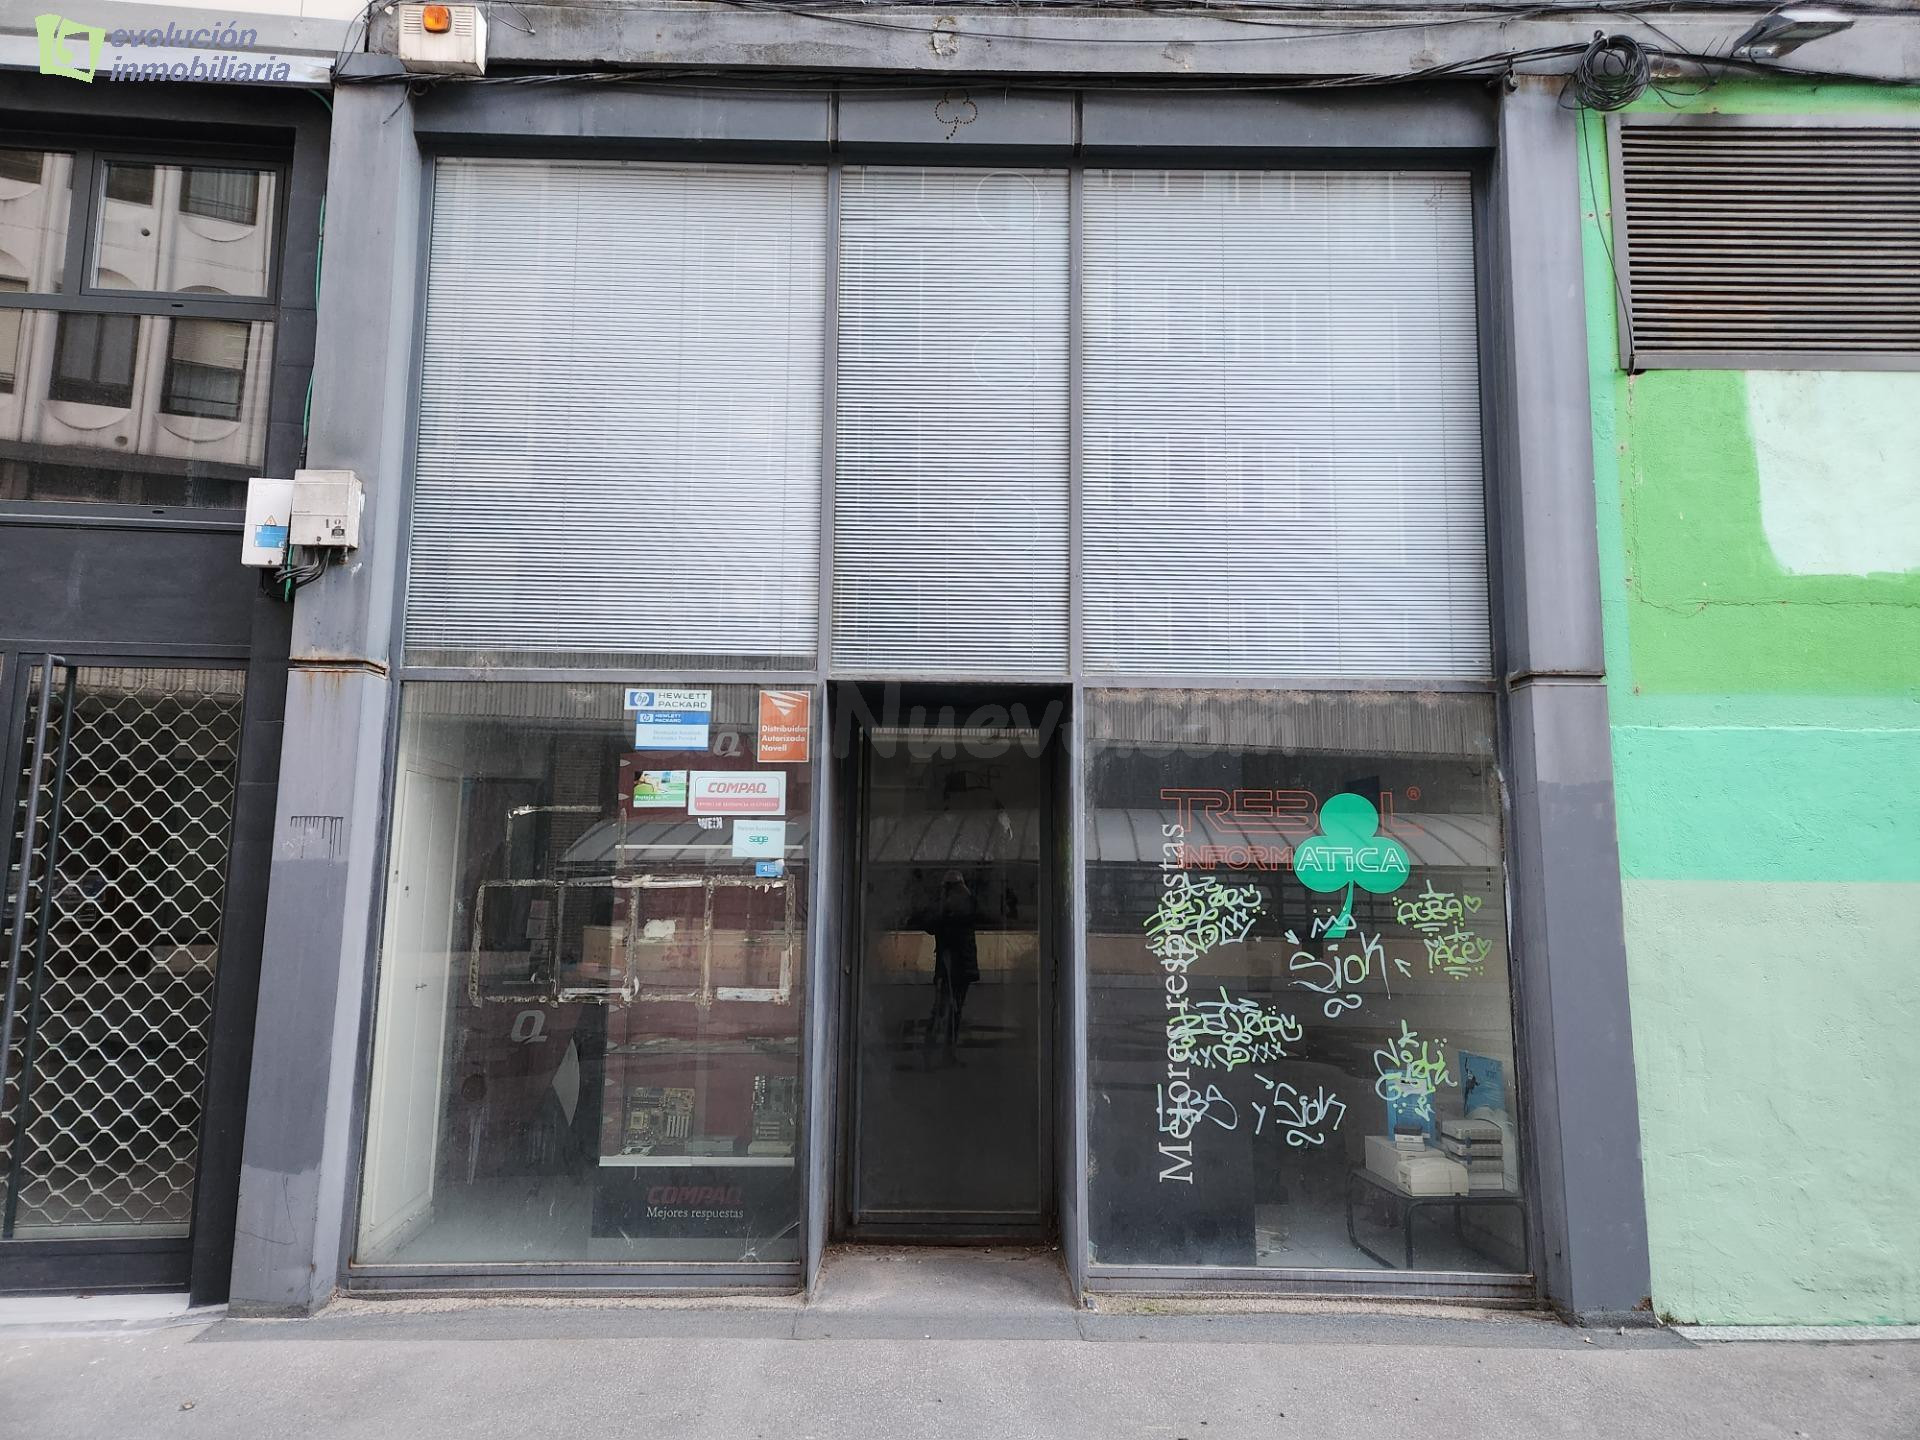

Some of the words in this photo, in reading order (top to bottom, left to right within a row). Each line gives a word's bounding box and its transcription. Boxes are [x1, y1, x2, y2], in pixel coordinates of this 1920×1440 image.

[658, 692, 708, 700] HEWLETT
[657, 701, 708, 709] PACKARD
[761, 724, 808, 733] Distribuidor
[761, 734, 806, 742] Autorizado
[761, 744, 788, 752] Novell
[707, 782, 768, 794] COMPAQ
[749, 835, 769, 845] sage
[646, 1206, 689, 1221] Mejores
[690, 1208, 744, 1221] respuestas
